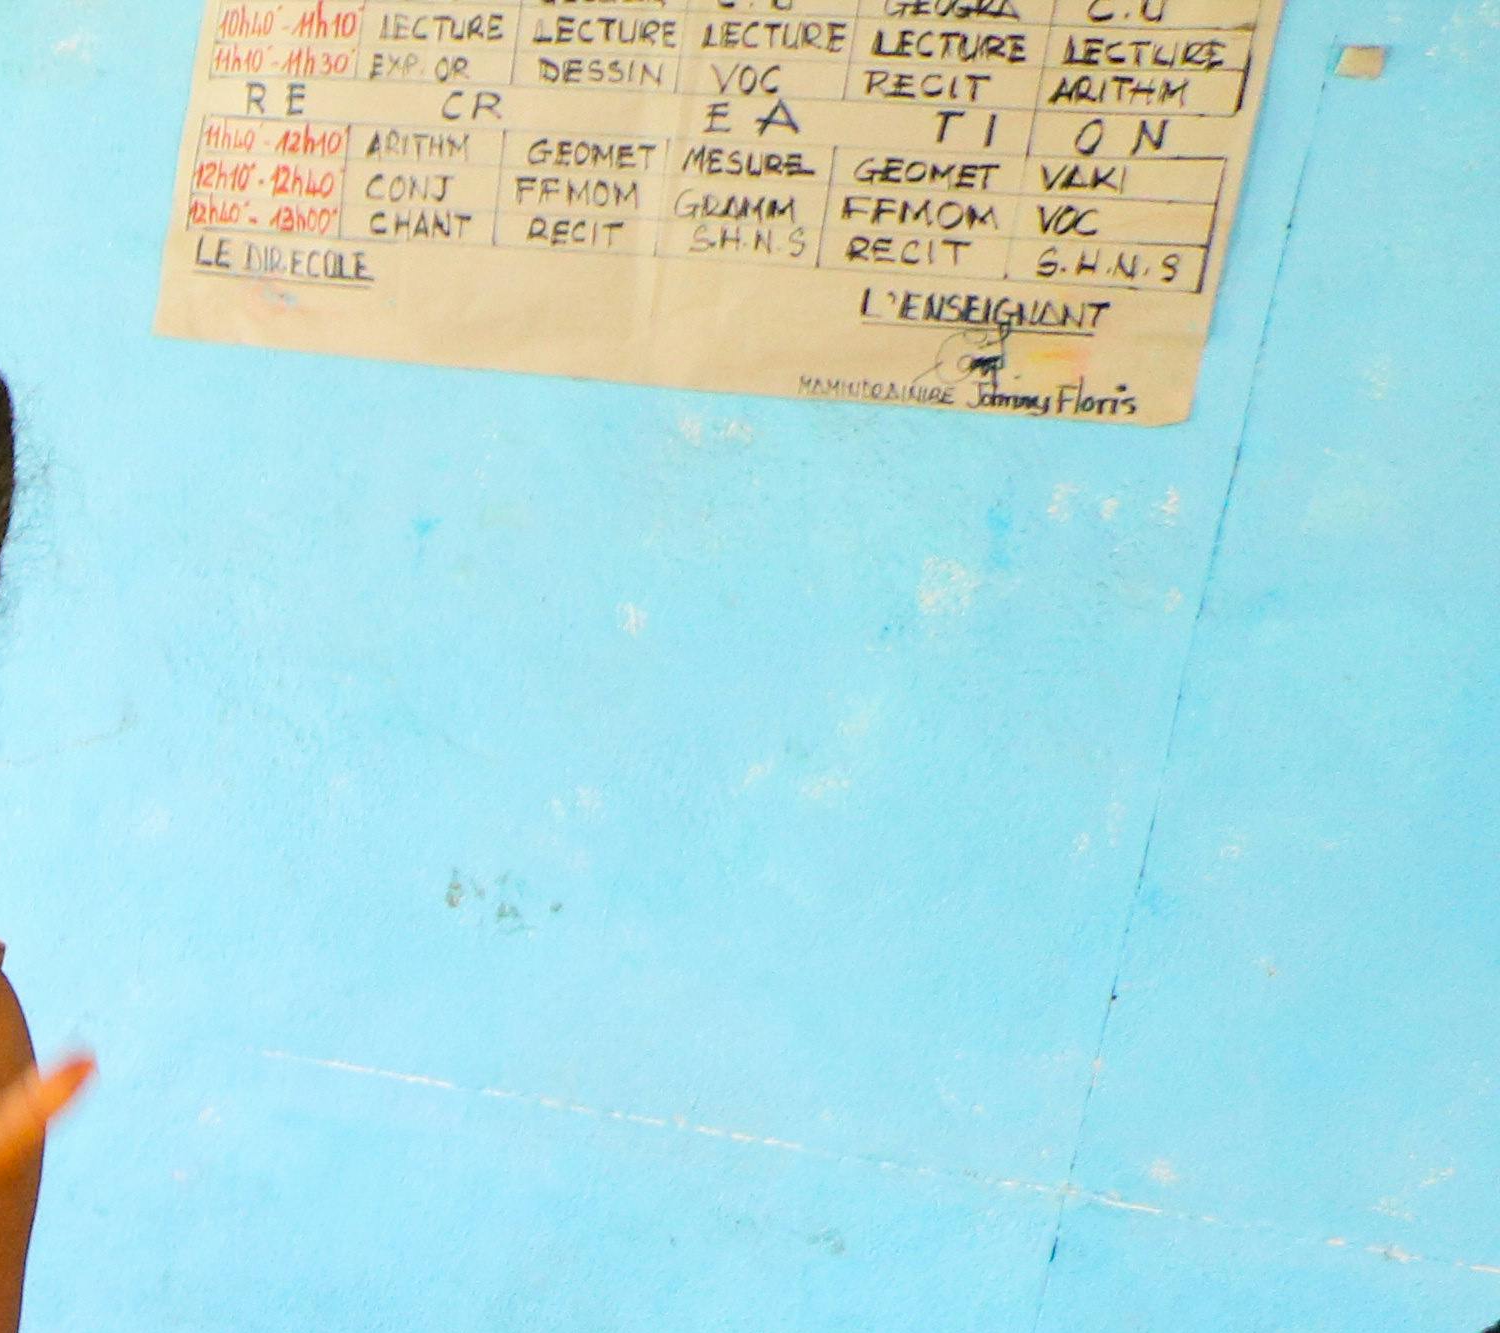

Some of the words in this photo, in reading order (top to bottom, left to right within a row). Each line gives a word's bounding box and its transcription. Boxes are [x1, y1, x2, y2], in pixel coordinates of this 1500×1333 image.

[380, 14, 503, 42] LECTURE
[533, 16, 677, 47] LECTURE
[701, 21, 847, 51] LECTURE
[872, 29, 1027, 62] LECTURE
[1064, 34, 1228, 70] LECTURE
[538, 56, 663, 85] DESSIN
[712, 63, 781, 95] VOC
[864, 70, 992, 101] RECIT
[1048, 75, 1190, 106] ARITHM
[366, 129, 470, 161] ARITHM
[527, 138, 657, 171] GEOMET
[682, 144, 816, 176] MESURE
[853, 157, 1000, 192] GEOMET
[365, 173, 455, 202] CONJ
[515, 175, 639, 208] FFMOM
[674, 188, 796, 222] GRAMM
[841, 196, 999, 231] FFMOM
[1037, 204, 1100, 237] VOC
[195, 234, 230, 269] LE
[368, 211, 473, 239] CHANT
[526, 216, 625, 247] RECIT
[844, 236, 972, 267] RECIT
[860, 287, 1111, 328] L'ENSEIGNANT
[1056, 376, 1138, 415] Floris
